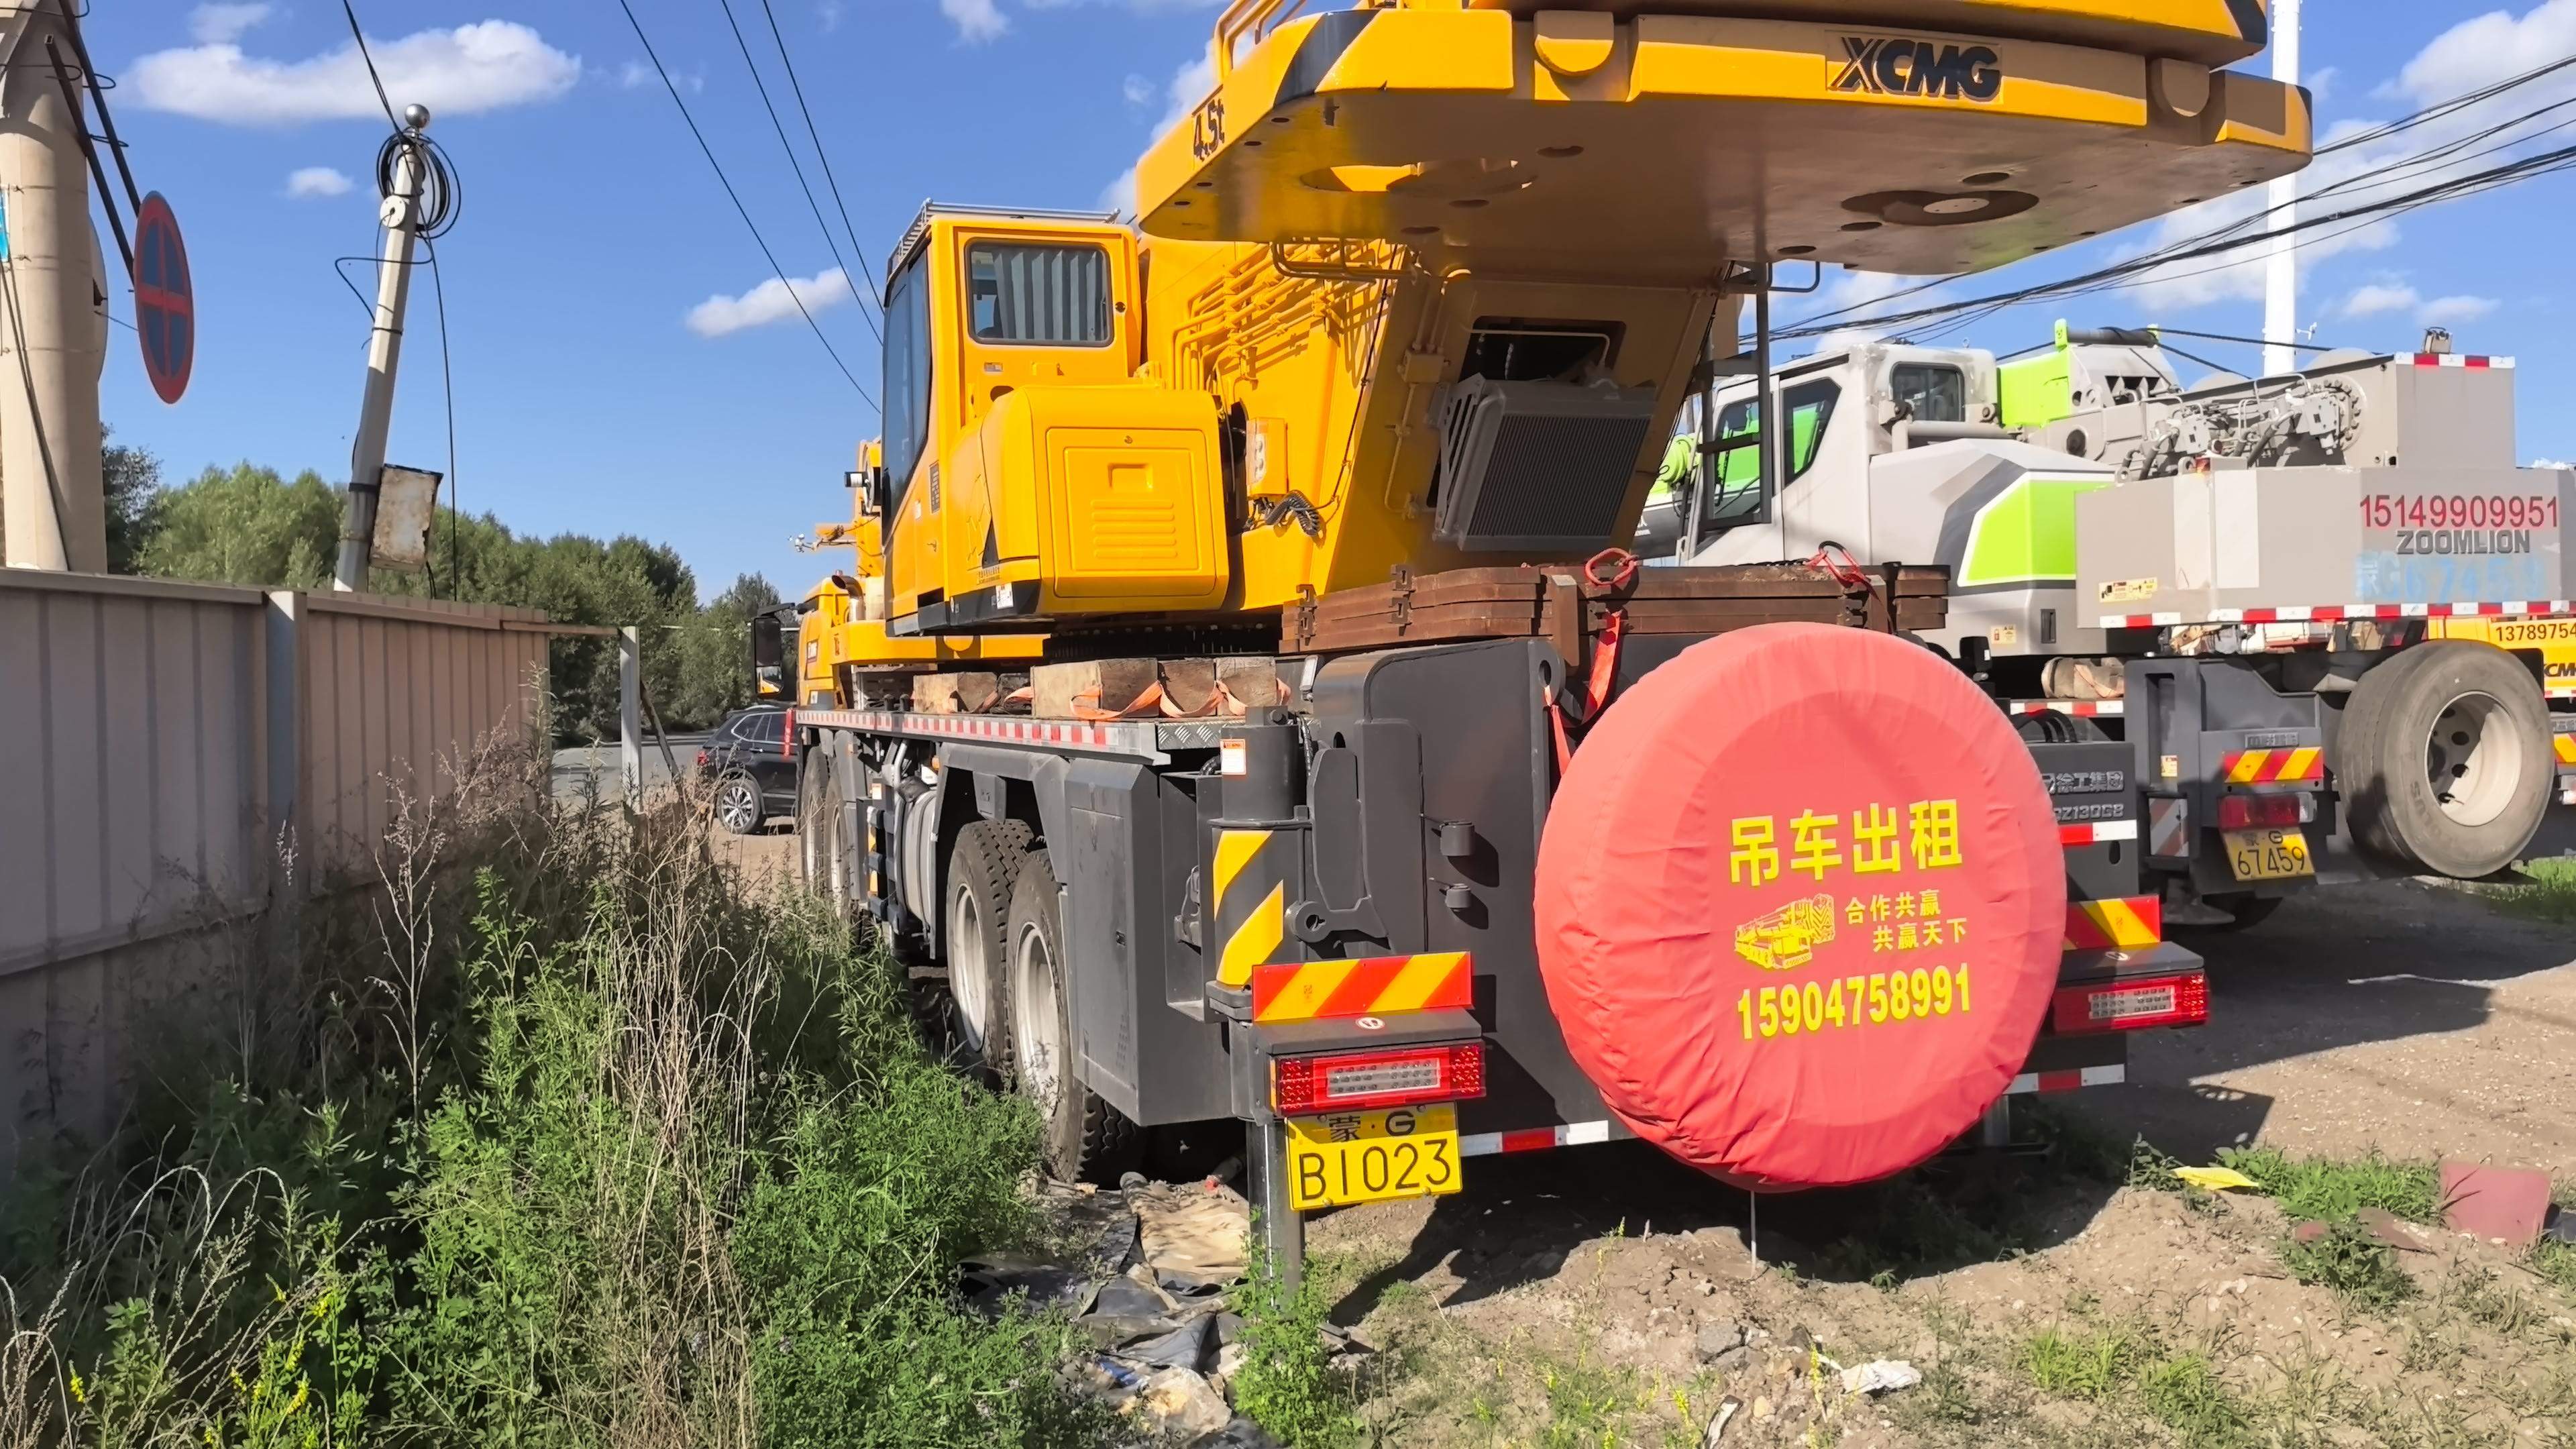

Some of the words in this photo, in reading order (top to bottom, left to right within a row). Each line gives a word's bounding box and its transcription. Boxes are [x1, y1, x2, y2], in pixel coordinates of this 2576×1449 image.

[1827, 37, 2000, 102] XCMG
[2360, 494, 2557, 527] 15149909951
[2397, 529, 2530, 555] ZOOMLION
[1730, 799, 1963, 886] 吊车出租
[2237, 847, 2305, 875] 67459
[1845, 889, 1941, 924] 合作共赢
[1872, 917, 1968, 953] 共赢天下
[1737, 963, 1970, 1040] 15904758991
[1299, 1138, 1450, 1201] B1023
